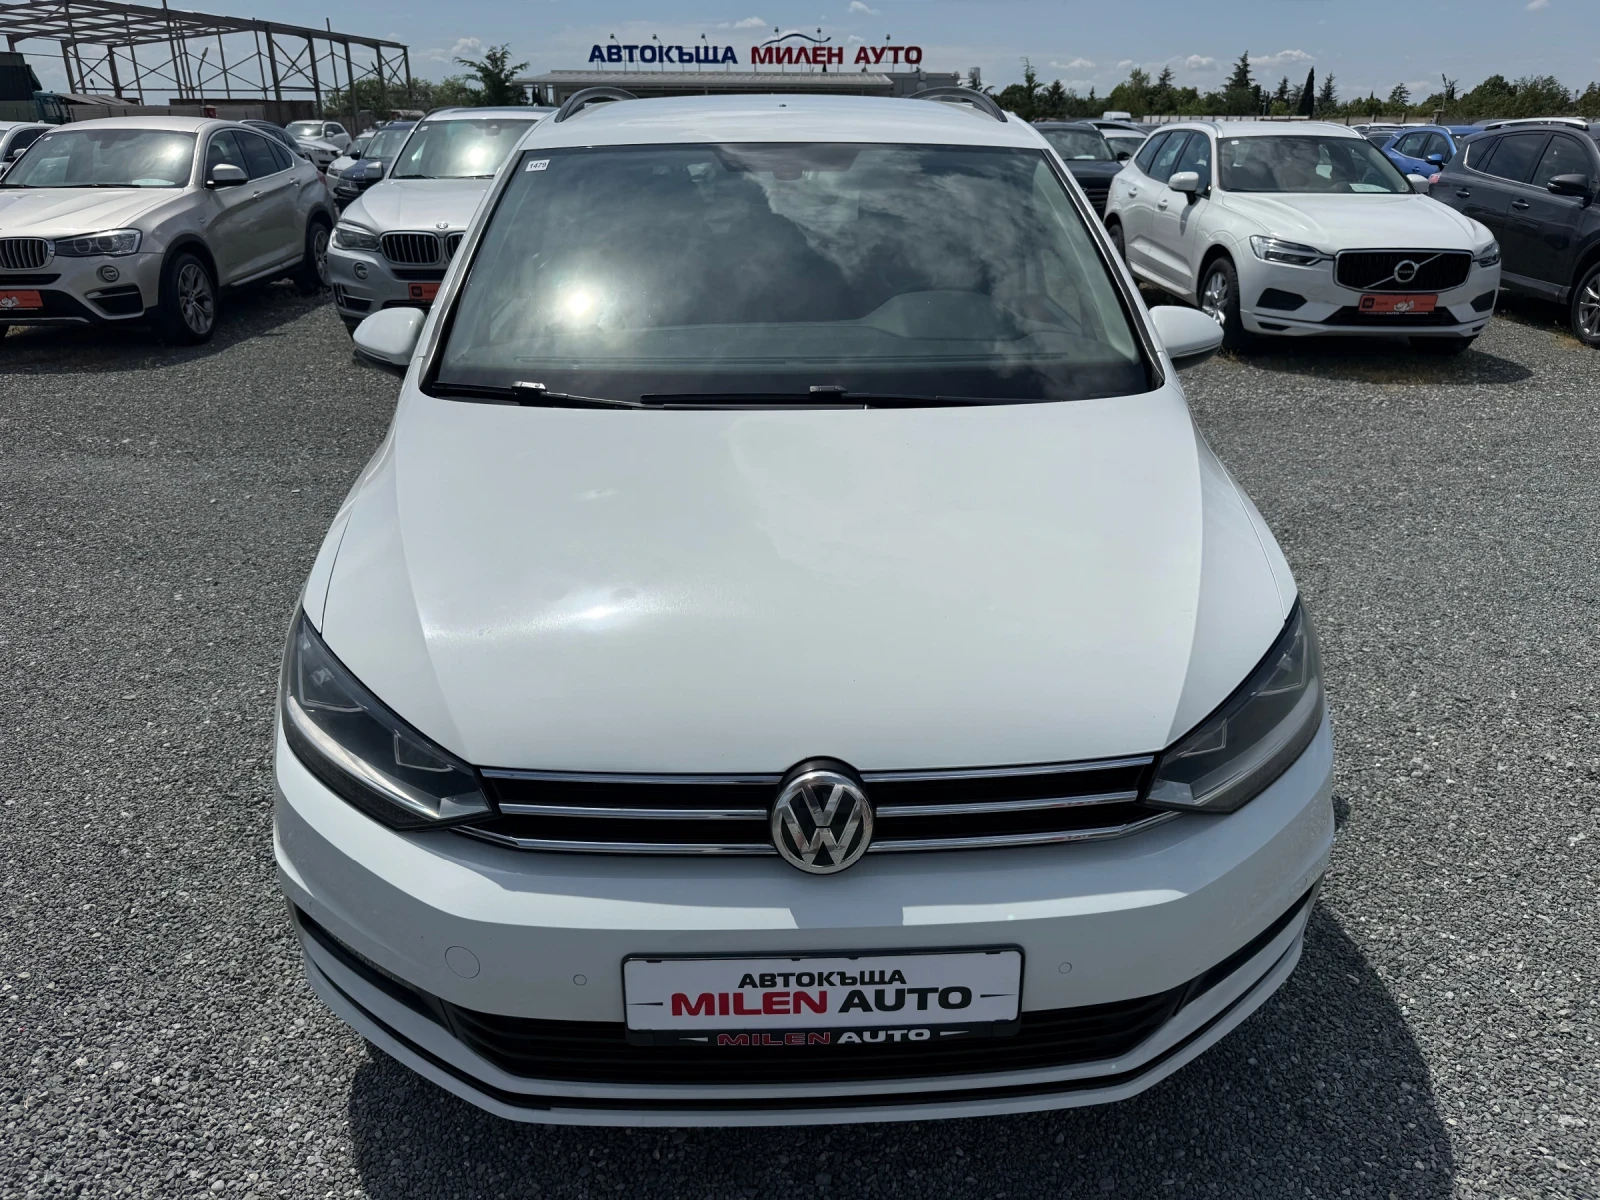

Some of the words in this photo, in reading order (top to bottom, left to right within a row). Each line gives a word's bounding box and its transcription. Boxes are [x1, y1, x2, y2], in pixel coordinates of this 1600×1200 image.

[588, 45, 738, 64] АВТОКЪЩА
[751, 46, 843, 65] МИЛЕН
[854, 46, 923, 65] АУТО
[737, 969, 907, 989] АВТОКЪЩА
[671, 990, 828, 1016] MILEN
[838, 986, 973, 1013] AUTO
[716, 1032, 831, 1046] MILEN
[837, 1028, 931, 1044] AUTO
